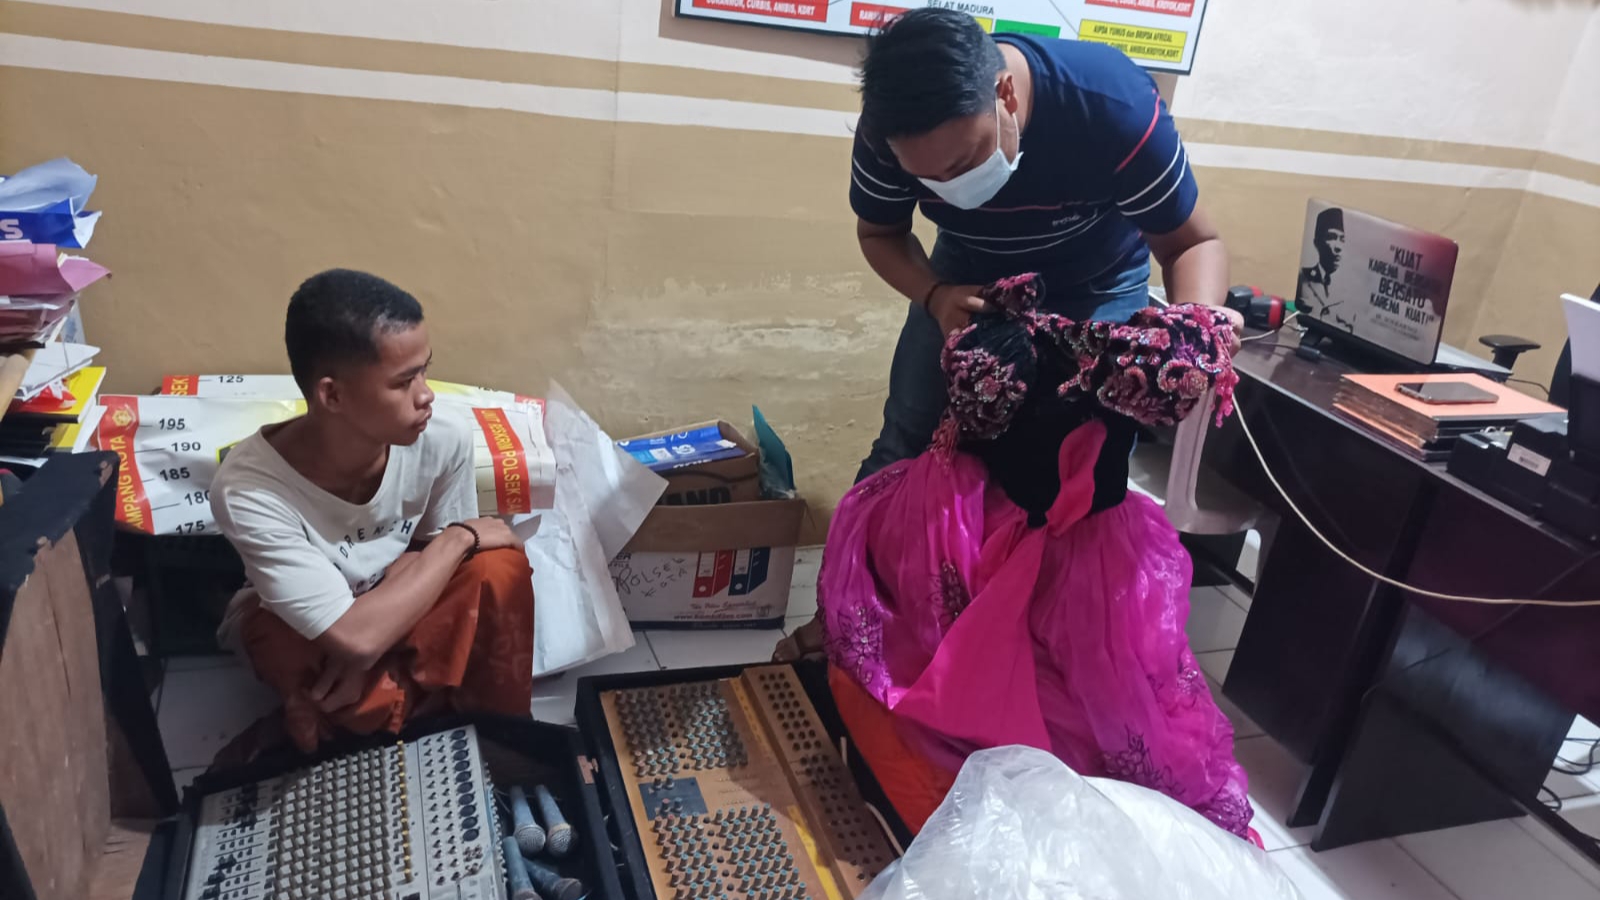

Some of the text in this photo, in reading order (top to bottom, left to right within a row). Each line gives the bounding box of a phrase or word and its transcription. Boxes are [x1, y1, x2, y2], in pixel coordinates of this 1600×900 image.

[957, 2, 995, 15] MADURA
[1368, 257, 1399, 279] KARENA
[1379, 276, 1427, 309] BERSATU
[1369, 293, 1400, 316] KARENA
[218, 375, 244, 384] 125
[158, 418, 186, 431] 195
[171, 441, 202, 453] 190
[159, 466, 191, 482] 185
[501, 450, 521, 496] POLSEK
[176, 520, 206, 535] 175
